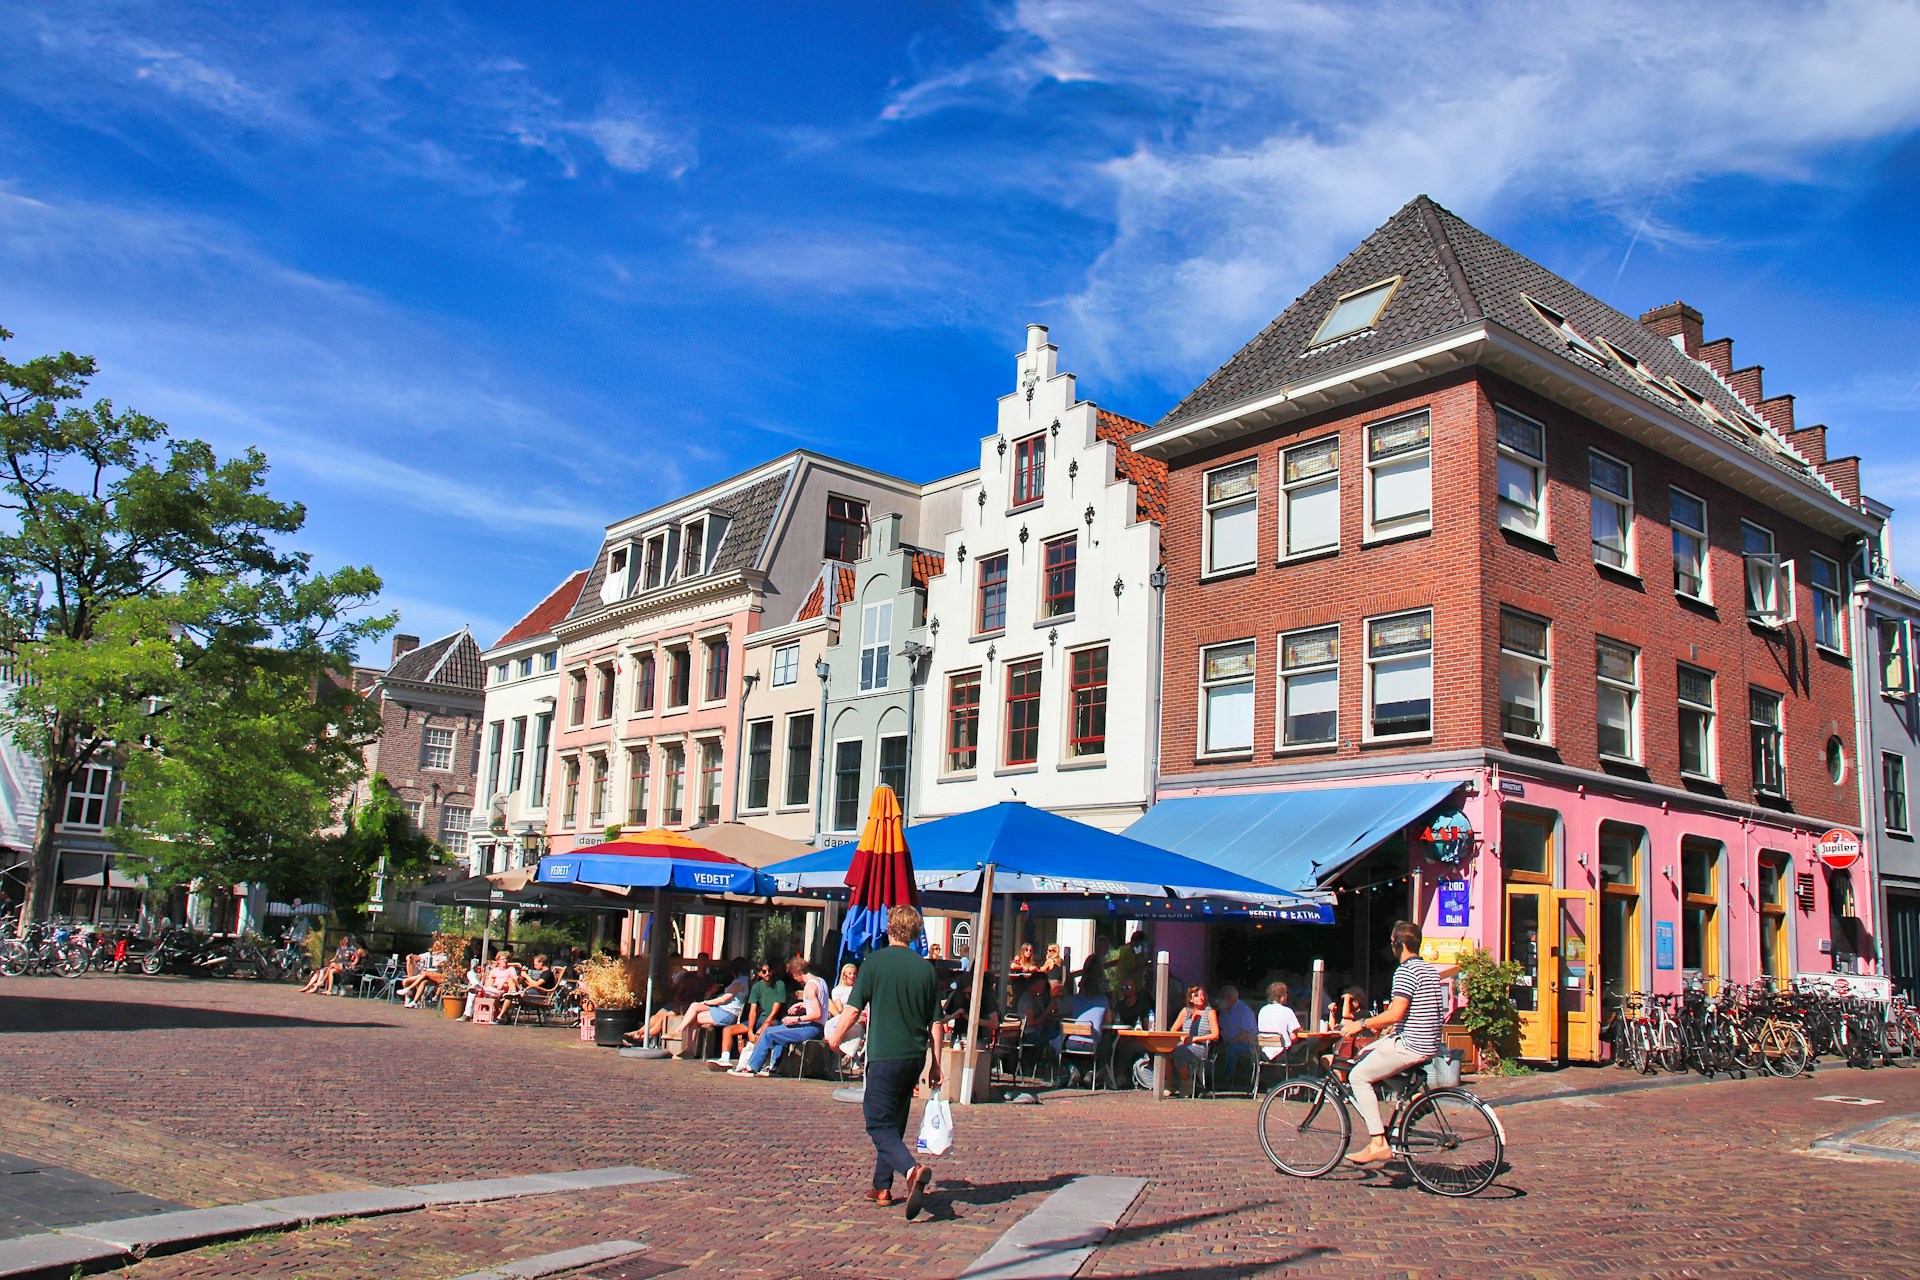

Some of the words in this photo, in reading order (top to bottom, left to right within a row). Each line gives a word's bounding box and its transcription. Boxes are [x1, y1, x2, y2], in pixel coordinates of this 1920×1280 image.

[607, 683, 621, 813] BRANDWEER
[1822, 843, 1857, 853] Jupiler
[550, 865, 569, 876] VEDETT
[694, 873, 731, 885] VEDETT
[1248, 910, 1277, 919] VEDETT
[1290, 910, 1321, 920] EXTRA
[1446, 914, 1463, 924] OWN
